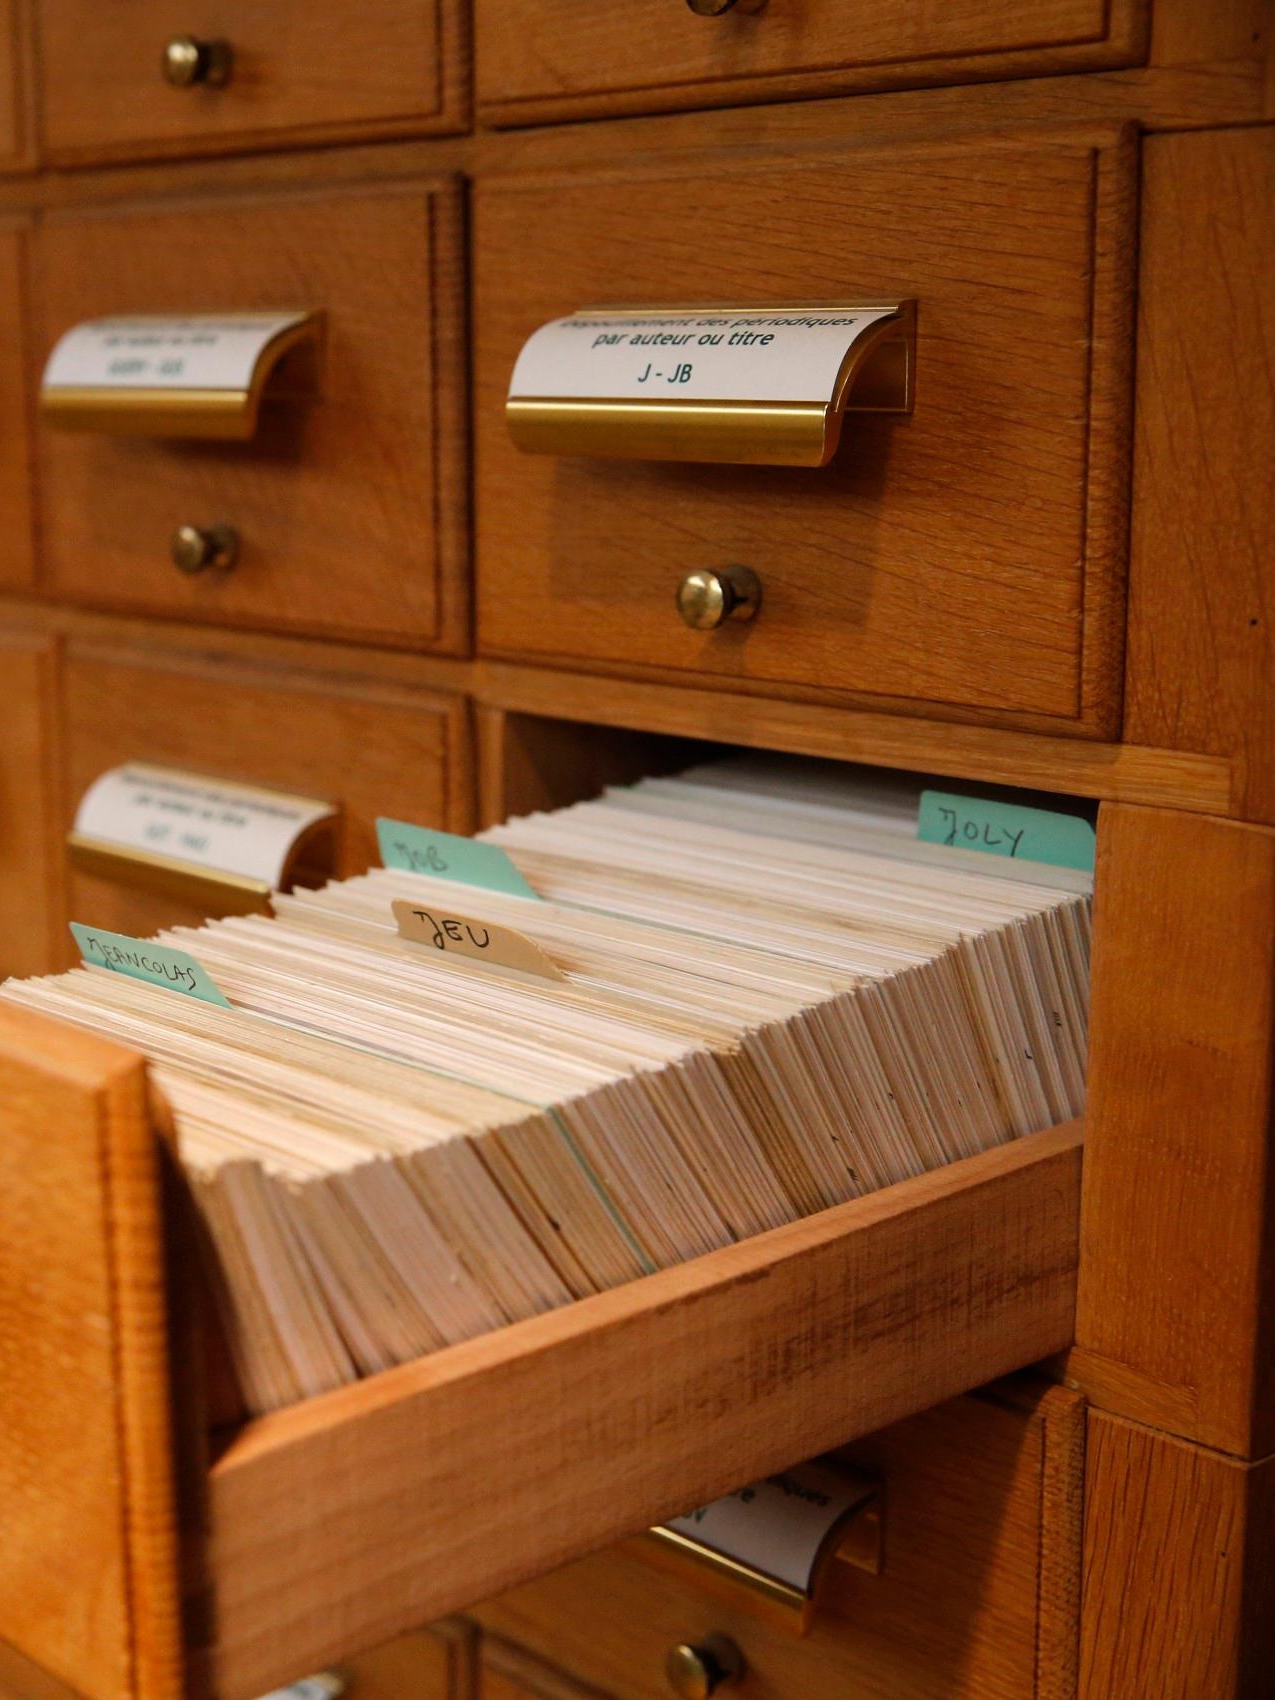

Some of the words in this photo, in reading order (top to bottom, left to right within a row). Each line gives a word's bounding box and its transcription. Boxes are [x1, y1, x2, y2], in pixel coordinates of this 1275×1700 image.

[729, 316, 859, 328] périodiques
[591, 333, 629, 349] par
[629, 332, 695, 346] auteur
[697, 334, 725, 346] ou
[727, 331, 775, 346] titre
[637, 363, 652, 383] J
[667, 363, 693, 383] JB
[938, 807, 1024, 858] JOLY
[412, 910, 490, 950] JEU
[86, 937, 197, 991] JEANCOLAS
